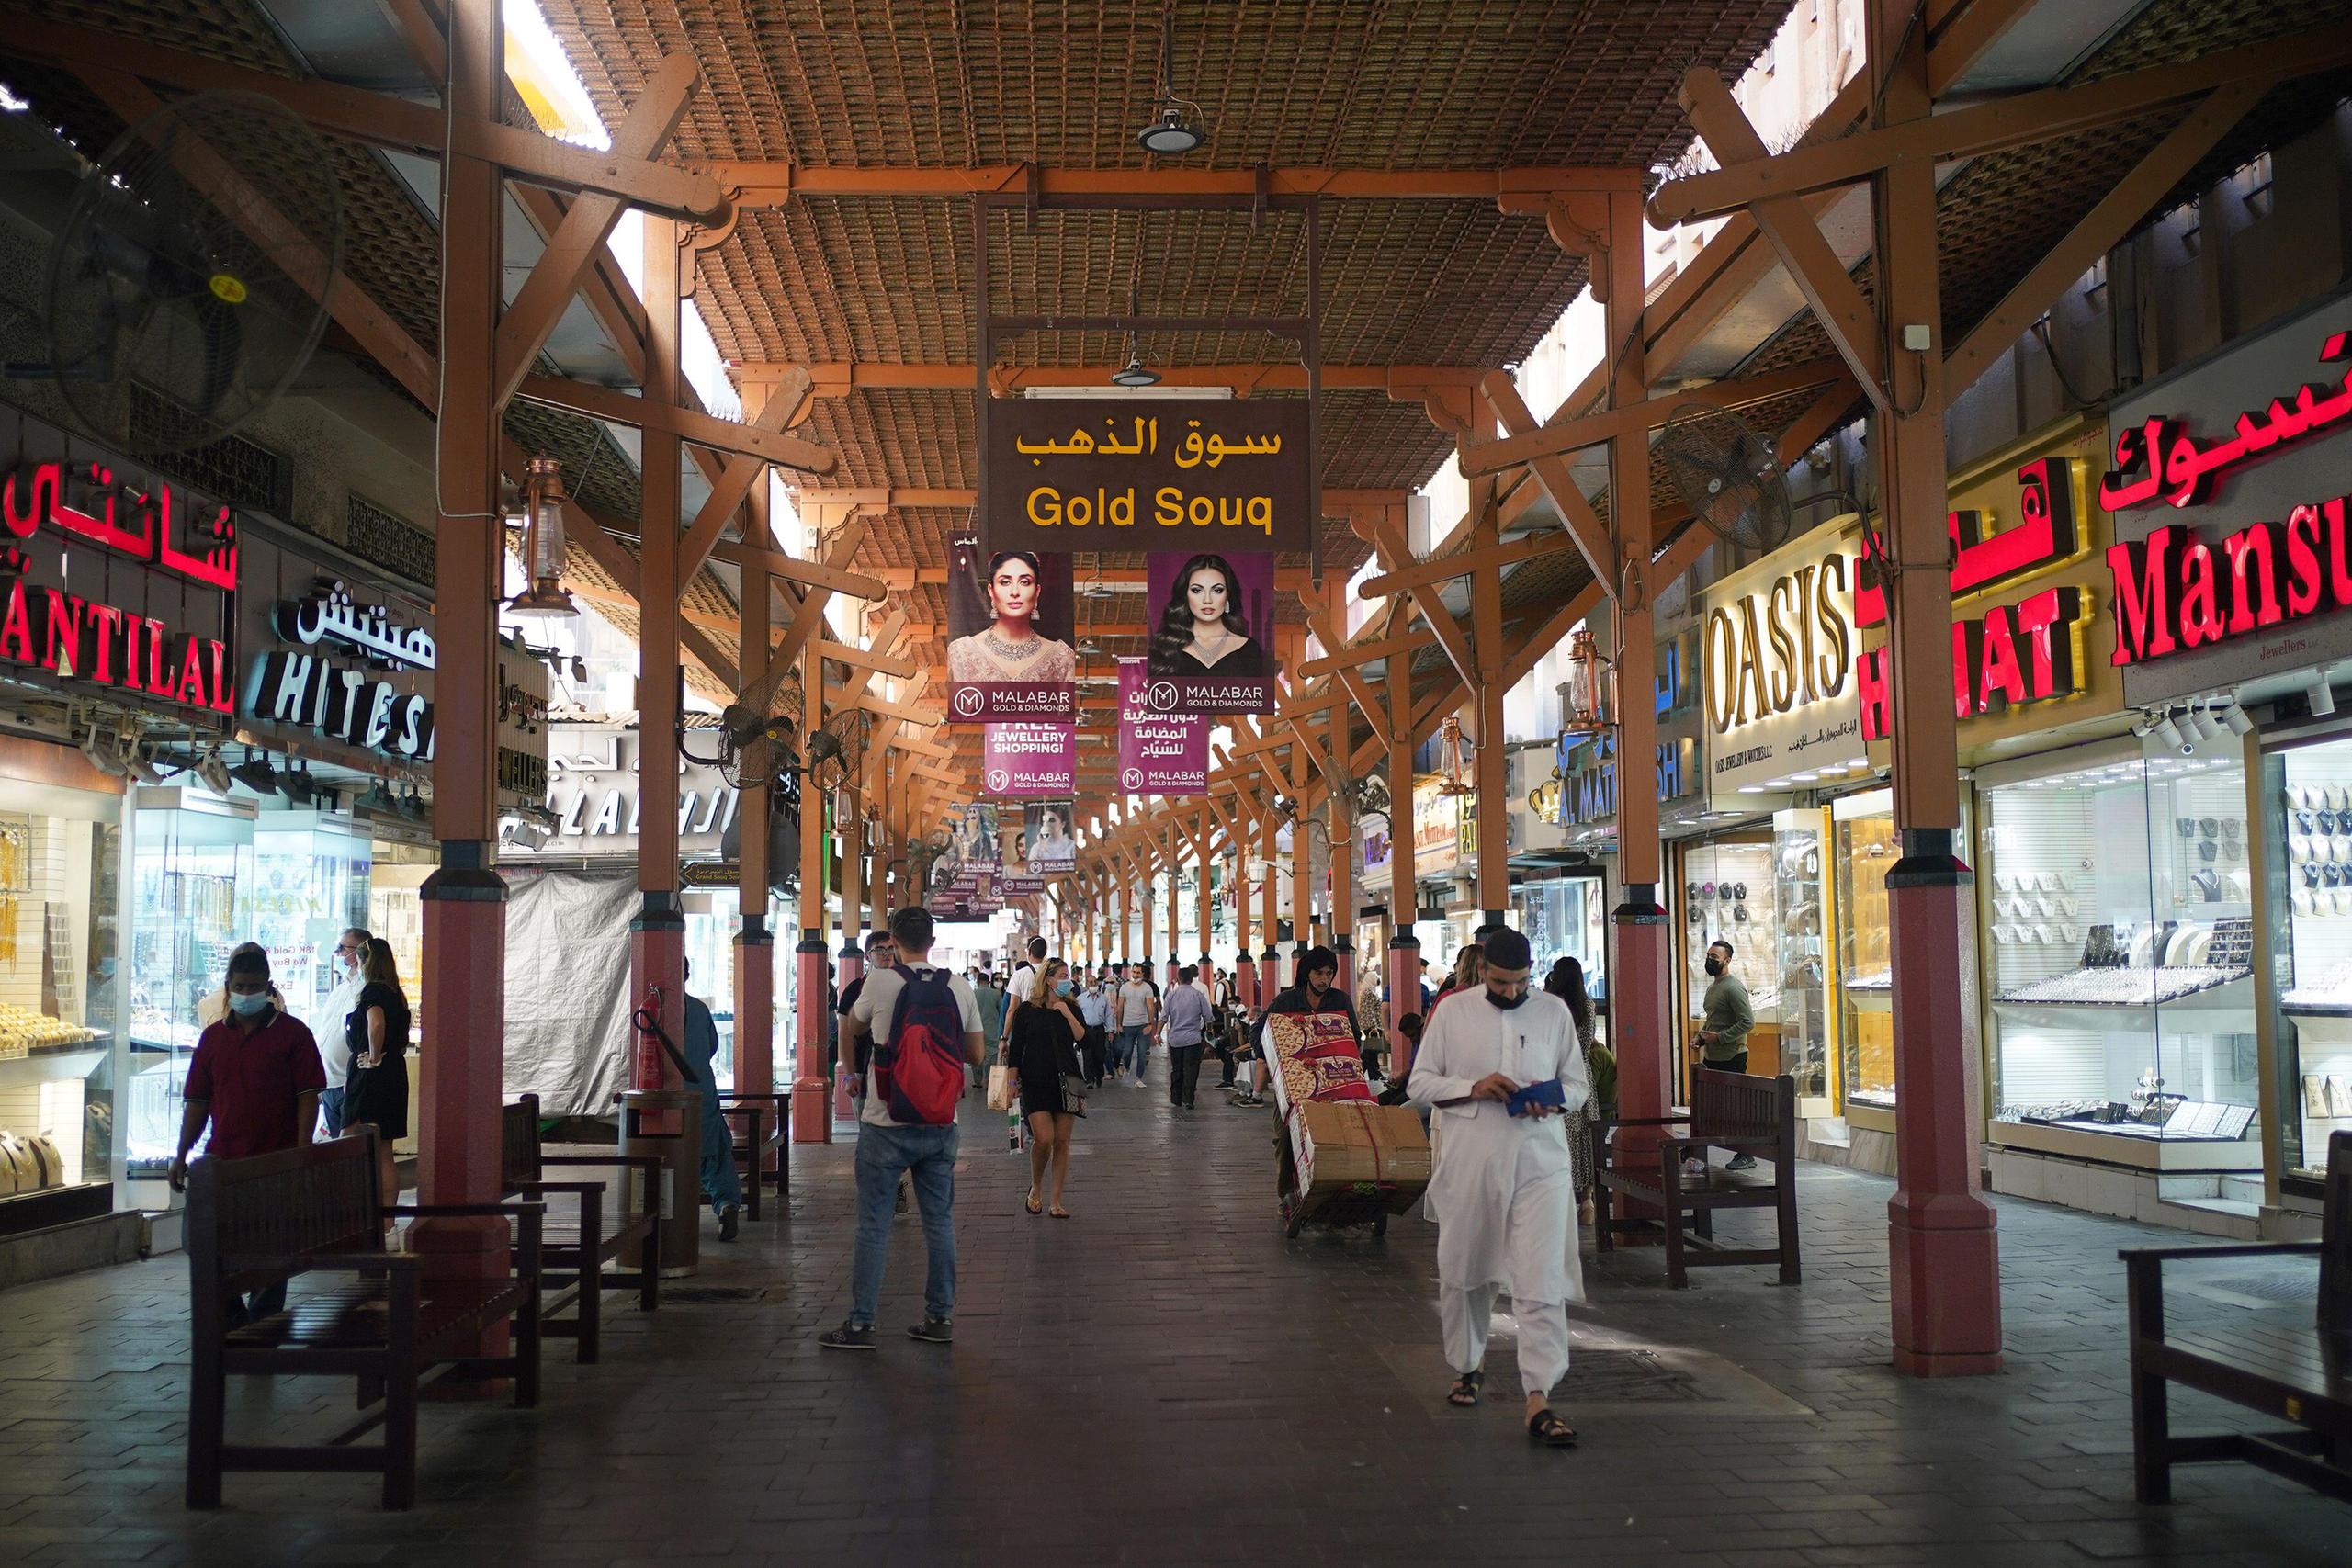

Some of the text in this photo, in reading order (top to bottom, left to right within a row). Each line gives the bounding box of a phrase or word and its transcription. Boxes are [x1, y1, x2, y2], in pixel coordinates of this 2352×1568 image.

[1016, 416, 1283, 468] سوق الذهب
[1026, 486, 1273, 536] Gold Souq
[1704, 553, 1849, 733] OASIS
[2260, 638, 2306, 660] Jewellers
[992, 691, 1070, 704] MALABAR
[1186, 686, 1263, 699] MALABAR
[275, 650, 435, 761] HITES
[1186, 699, 1263, 707] GOLD & DIAMONDS
[990, 732, 1067, 742] JEWELLERY
[1135, 726, 1187, 739] المضافة
[993, 743, 1064, 754] SHOPPING!
[1014, 773, 1070, 782] MALABAR
[1148, 771, 1204, 780] MALABAR
